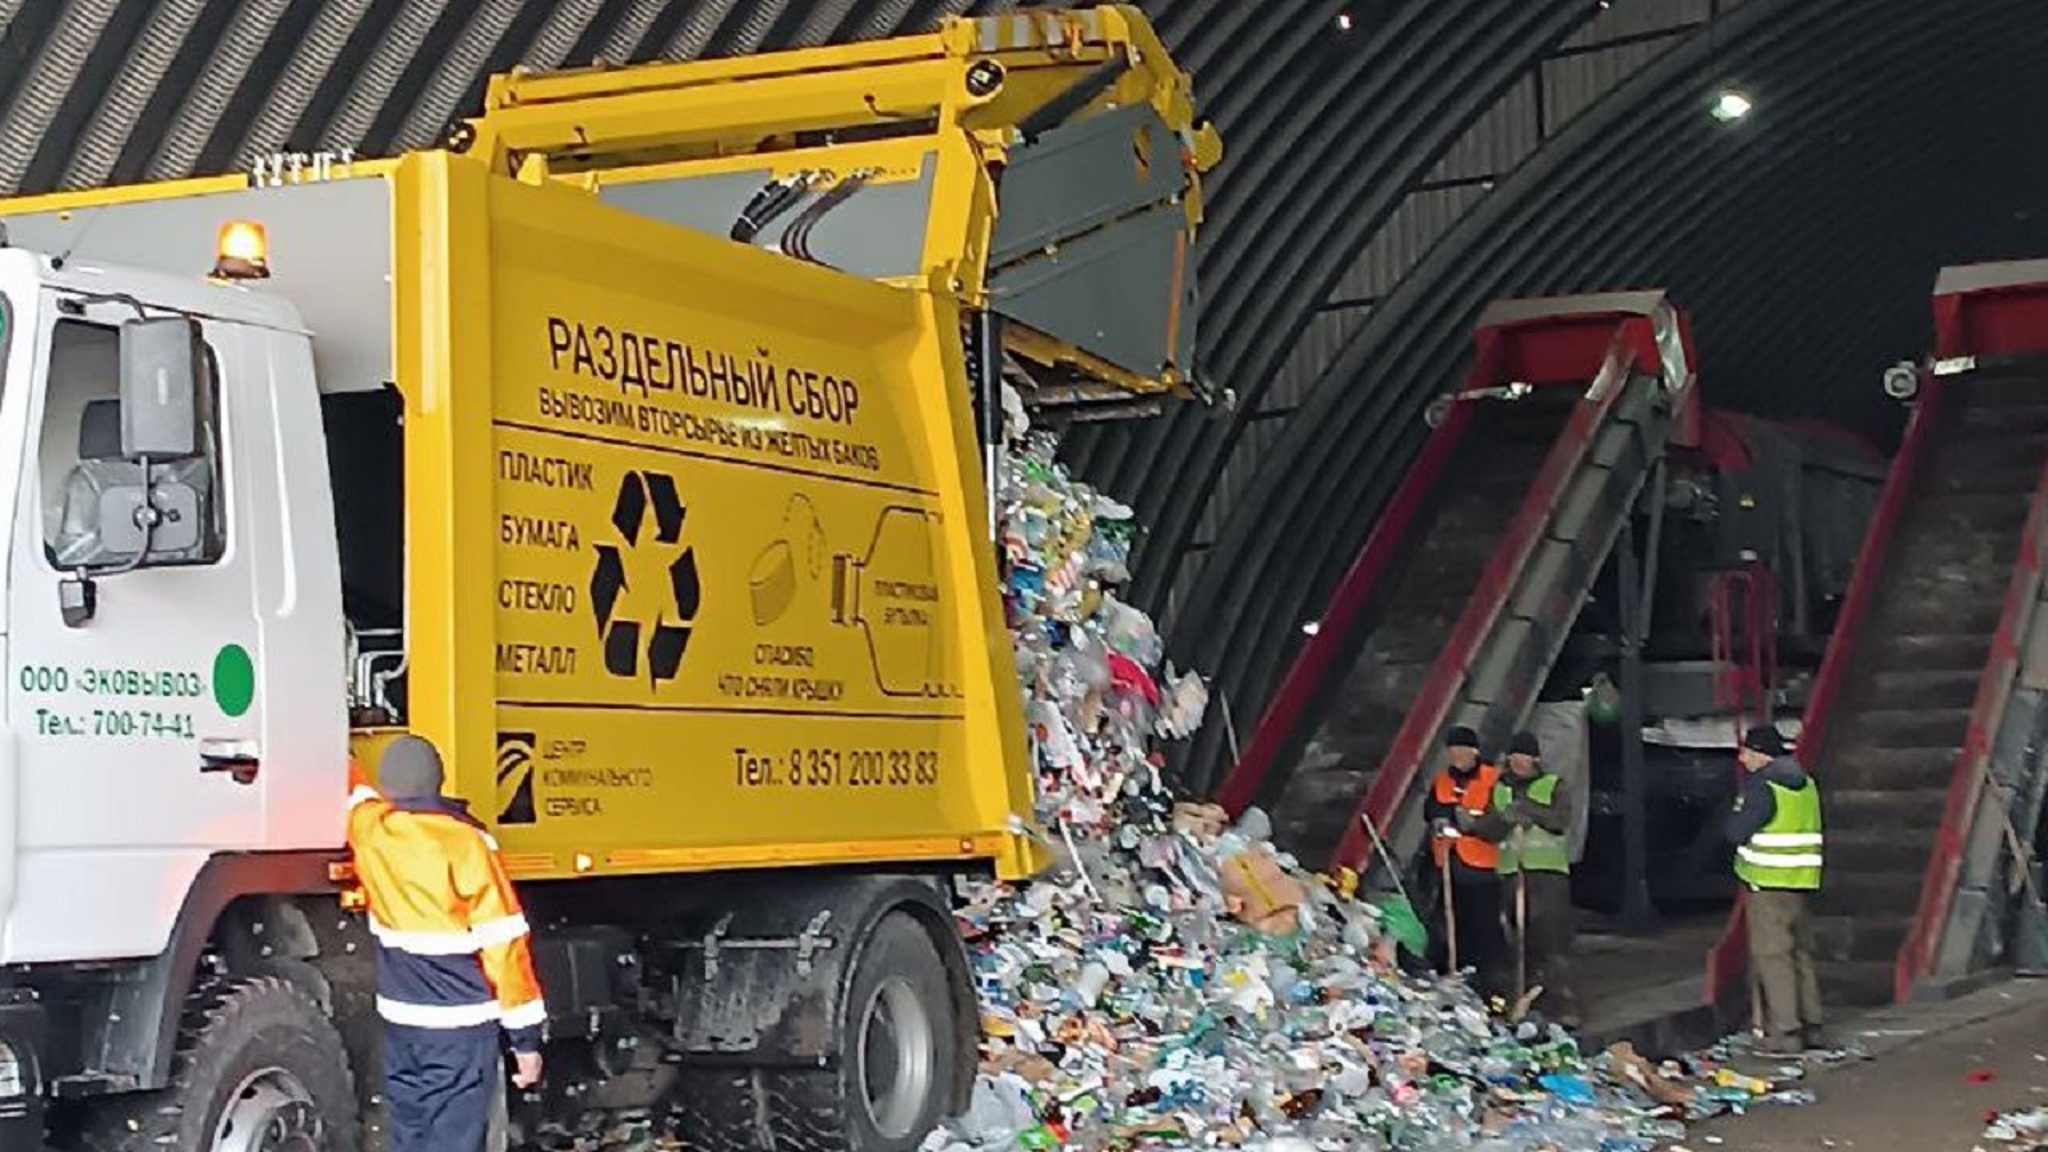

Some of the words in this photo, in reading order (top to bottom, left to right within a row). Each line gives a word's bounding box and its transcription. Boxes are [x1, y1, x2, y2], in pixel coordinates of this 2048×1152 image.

[547, 317, 781, 413] РАЗДЕЛЬНЫЙ
[786, 367, 859, 426] СБОР
[539, 386, 635, 430] ВЫВОЗИМ
[637, 404, 738, 448] ВТОРСЫРЬЕ
[742, 426, 762, 450] ИЗ
[832, 439, 880, 471] БАКОВ
[499, 450, 593, 490] ПЛАСТИК
[501, 513, 580, 551] БУМАГА
[499, 579, 576, 614] СТЕКЛО
[495, 643, 576, 676] МЕТАЛЛ
[755, 644, 814, 667] СПАСИБО
[20, 665, 68, 692] ООО
[36, 708, 85, 735] Тел.:
[93, 709, 196, 738] 700-74-41
[735, 748, 783, 786] Тел.:
[789, 748, 802, 786] 8
[807, 748, 841, 786] 351
[848, 750, 884, 786] 200
[887, 750, 911, 786] 33
[914, 750, 938, 786] 83
